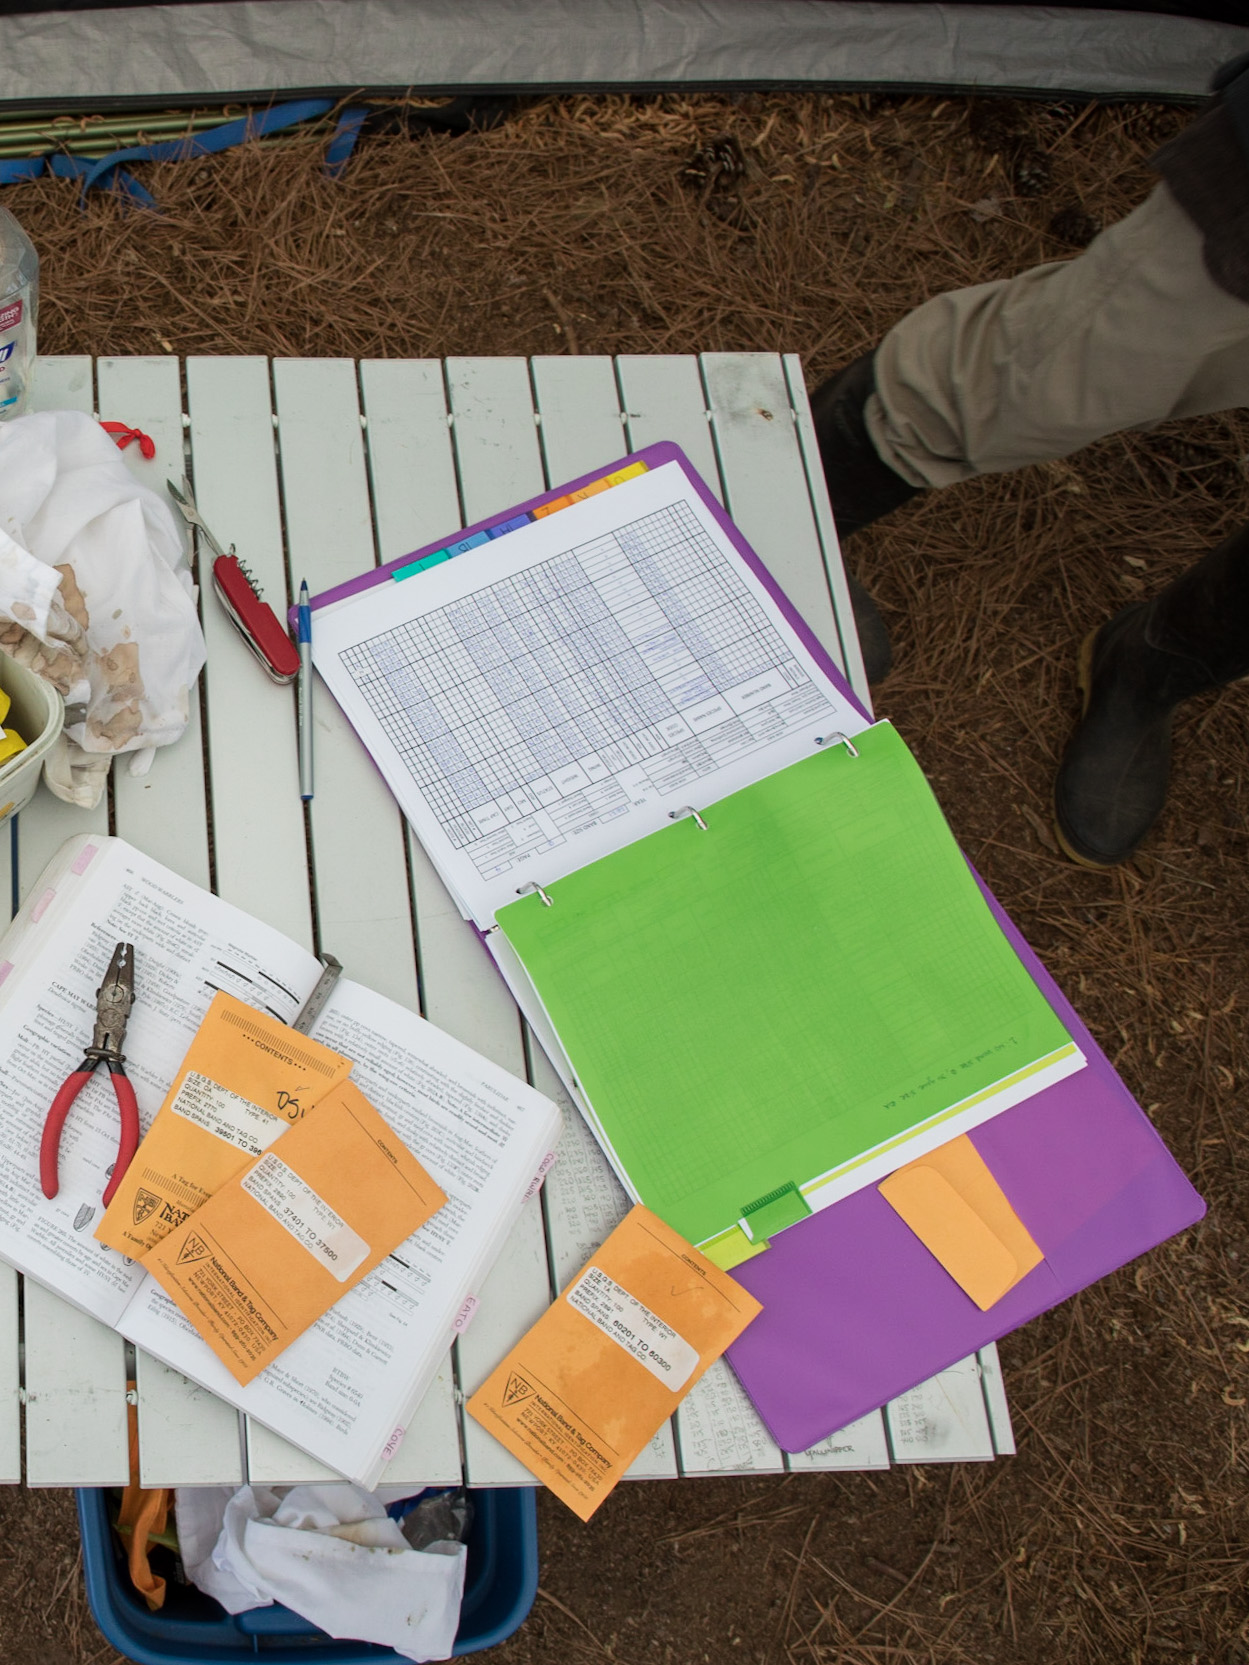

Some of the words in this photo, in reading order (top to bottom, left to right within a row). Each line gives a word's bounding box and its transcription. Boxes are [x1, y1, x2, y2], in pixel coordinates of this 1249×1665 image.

[536, 784, 553, 797] STATUS
[560, 772, 578, 785] WEIGHT
[583, 819, 597, 830] BAND
[50, 980, 67, 993] CAPE
[67, 990, 80, 1000] MAY
[177, 1095, 206, 1115] NATIONAL
[205, 1111, 222, 1124] BAND
[221, 1120, 236, 1131] AND
[235, 1128, 248, 1138] TAG
[203, 1101, 217, 1112] 2770
[215, 1100, 225, 1108] 100
[229, 1092, 238, 1100] OF
[239, 1098, 251, 1107] THE
[250, 1104, 278, 1122] INTERIOR
[173, 1103, 191, 1116] BAND
[214, 1126, 235, 1141] 39501
[236, 1138, 248, 1148] TO
[376, 1138, 399, 1164] CONTENTS
[285, 1189, 296, 1199] 100
[301, 1186, 310, 1195] OF
[309, 1194, 321, 1205] THE
[319, 1204, 345, 1228] INTERIOR
[242, 1181, 269, 1205] NATIONAL
[267, 1204, 282, 1218] BAND
[281, 1217, 294, 1230] AND
[293, 1228, 305, 1240] TAG
[247, 1175, 264, 1191] BAND
[282, 1206, 305, 1228] 37401
[303, 1227, 317, 1240] TO
[314, 1238, 338, 1261] 37500
[187, 1236, 205, 1256] NB
[204, 1276, 218, 1291] YORK
[215, 1290, 233, 1311] STREET
[236, 1315, 245, 1325] PO
[242, 1324, 254, 1336] BOX
[209, 1256, 232, 1282] National
[228, 1279, 244, 1297] Band
[240, 1294, 248, 1302] &
[244, 1300, 257, 1314] Tag
[252, 1310, 280, 1341] Company
[453, 1295, 476, 1329] EATO
[612, 1302, 623, 1312] 100
[216, 1301, 225, 1310] KY
[250, 1342, 262, 1356] USA
[569, 1295, 597, 1319] NATIONAL
[596, 1317, 613, 1332] BAND
[612, 1330, 625, 1343] AND
[624, 1341, 637, 1353] TAG
[573, 1289, 590, 1304] BAND
[611, 1319, 635, 1340] 60201
[635, 1338, 649, 1352] TO
[647, 1349, 672, 1372] 60300
[629, 1298, 639, 1307] OF
[638, 1305, 650, 1317] THE
[648, 1314, 677, 1338] INTERIOR
[509, 1377, 529, 1395] NB
[382, 1426, 403, 1456] COYE
[533, 1394, 558, 1417] National
[555, 1414, 572, 1430] Band
[569, 1427, 577, 1435] &
[574, 1432, 587, 1445] Tag
[583, 1441, 614, 1469] Company
